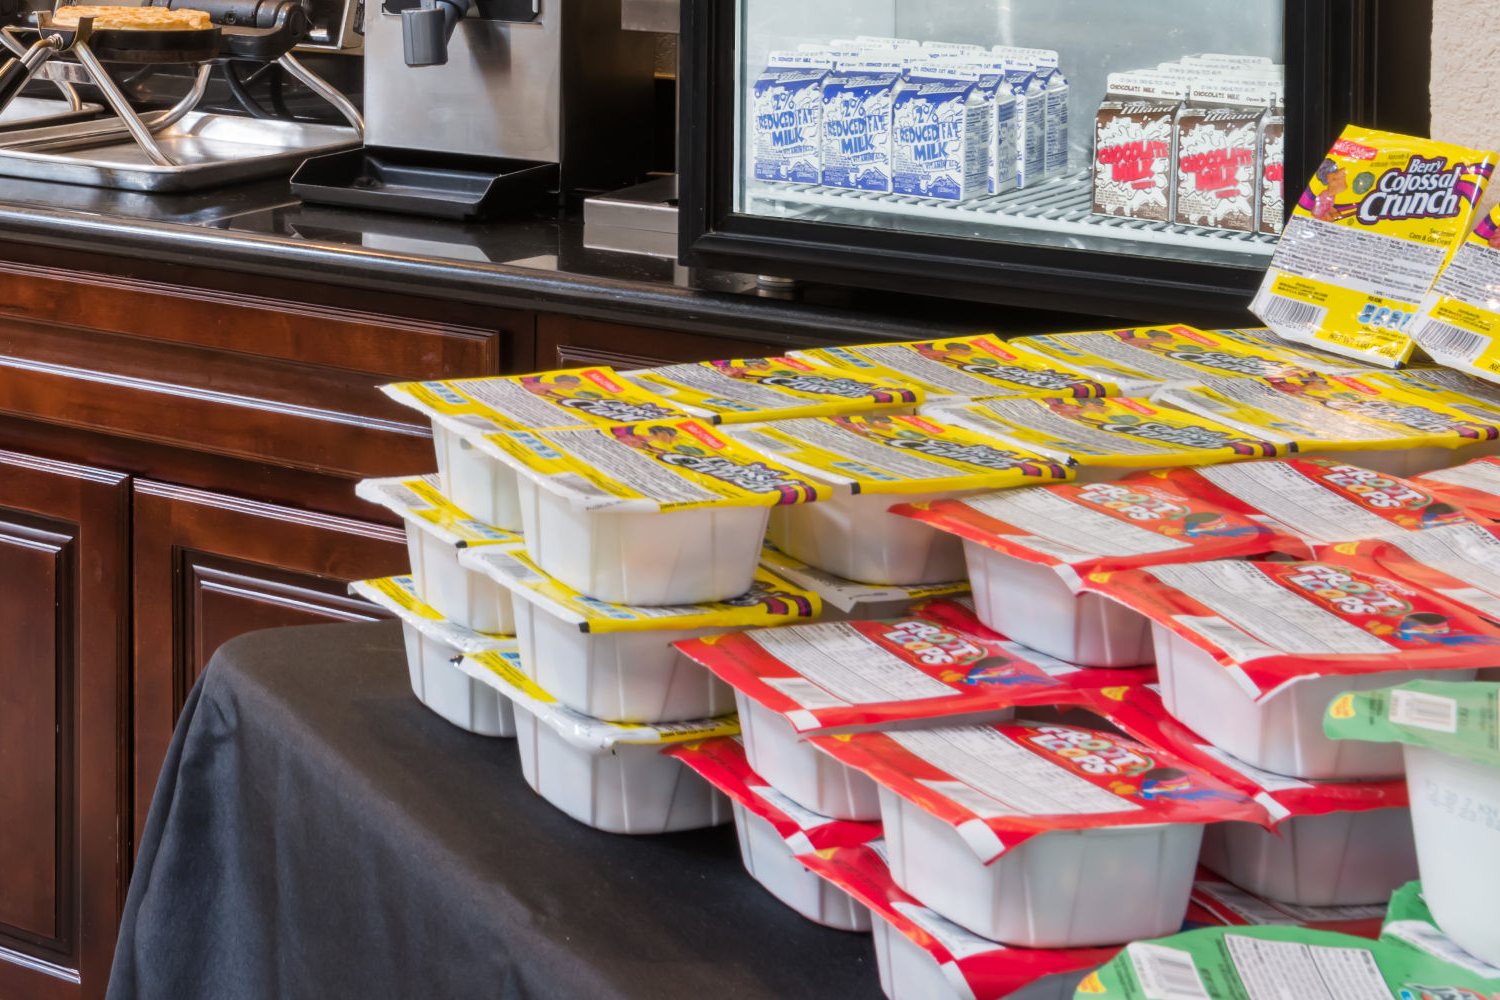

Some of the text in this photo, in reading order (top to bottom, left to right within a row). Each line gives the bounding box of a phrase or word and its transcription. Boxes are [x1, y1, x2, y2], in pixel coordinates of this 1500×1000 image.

[773, 90, 795, 110] 2%
[843, 98, 865, 117] 2%
[758, 108, 813, 130] REDUCED FAT
[827, 115, 884, 137] REDUCED FAT
[915, 105, 938, 124] 2%
[772, 127, 804, 147] MILK
[842, 135, 874, 154] MILK
[900, 122, 958, 143] REDUCED FAT
[913, 142, 948, 161] MILK
[1098, 140, 1168, 164] CHOCOLATE
[1180, 148, 1252, 173] CHOCOLATE
[1112, 159, 1154, 183] MILK
[1408, 158, 1444, 174] Berry
[1196, 167, 1239, 191] MILK
[1380, 166, 1461, 194] Colossal
[1359, 187, 1458, 221] Crunch
[1322, 473, 1401, 507] LOOPS
[1329, 465, 1425, 501] FROOT
[1077, 492, 1161, 520] LOOPS
[1081, 483, 1182, 513] FROOT
[1287, 575, 1377, 614] LOOPS
[1295, 565, 1405, 608] FROOT
[882, 630, 954, 664] LOOPS
[892, 621, 981, 655] FROOT
[1029, 734, 1118, 774] LOOPS
[1037, 727, 1146, 765] FROOT
